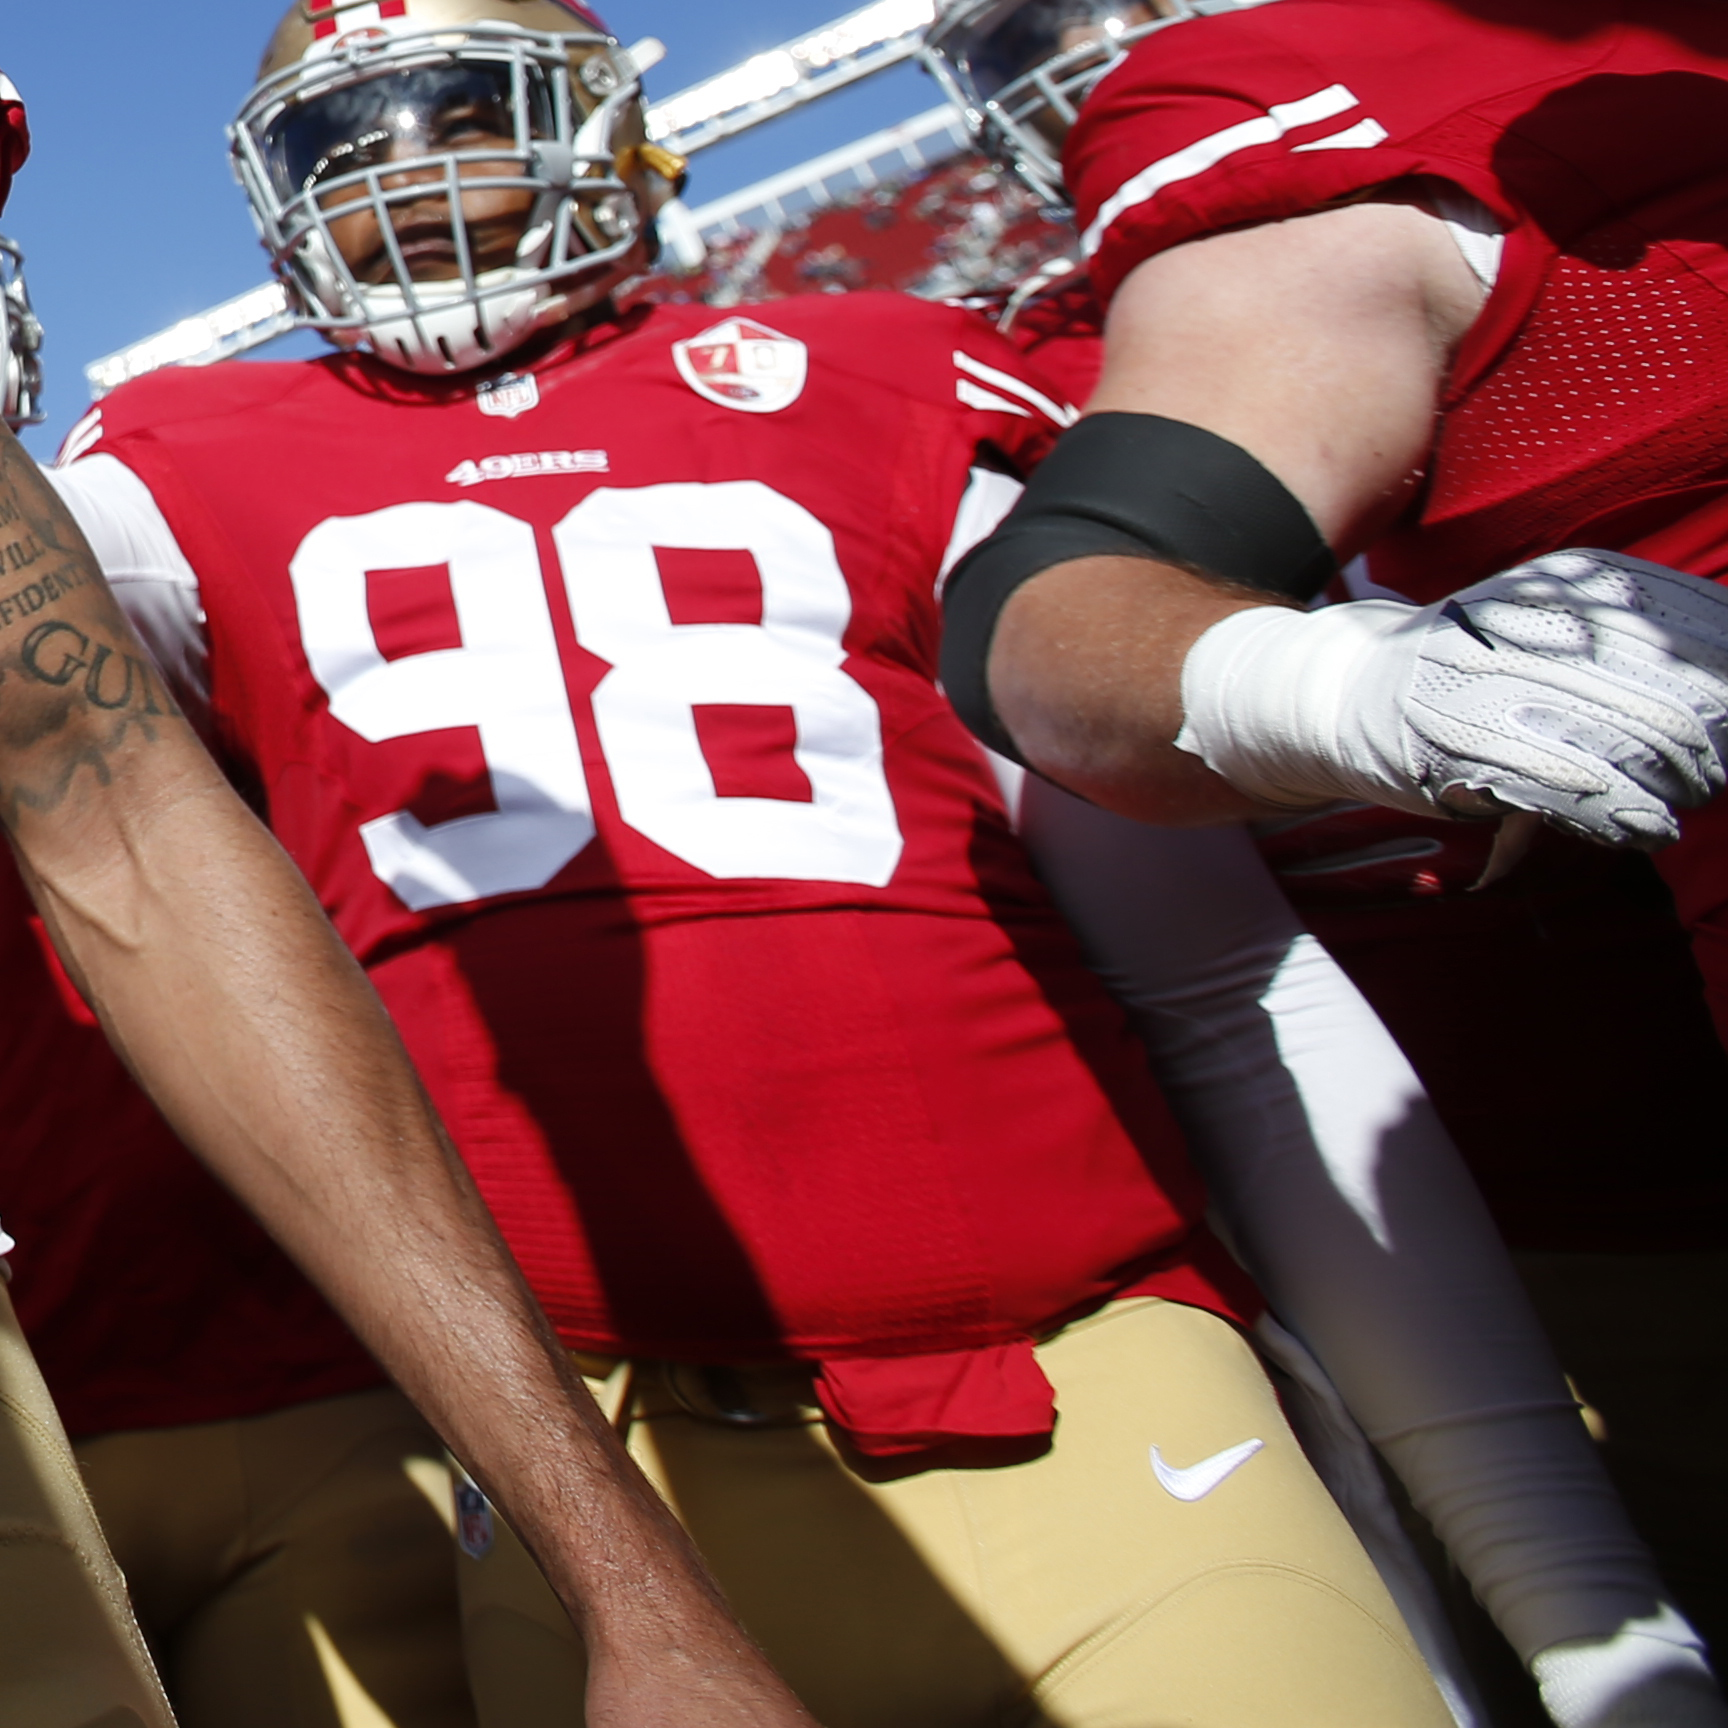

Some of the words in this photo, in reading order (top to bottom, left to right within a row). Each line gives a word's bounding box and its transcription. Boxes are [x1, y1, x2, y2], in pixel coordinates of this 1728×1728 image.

[490, 387, 530, 409] NFL
[446, 449, 610, 486] 49ERS
[288, 480, 905, 913] 98
